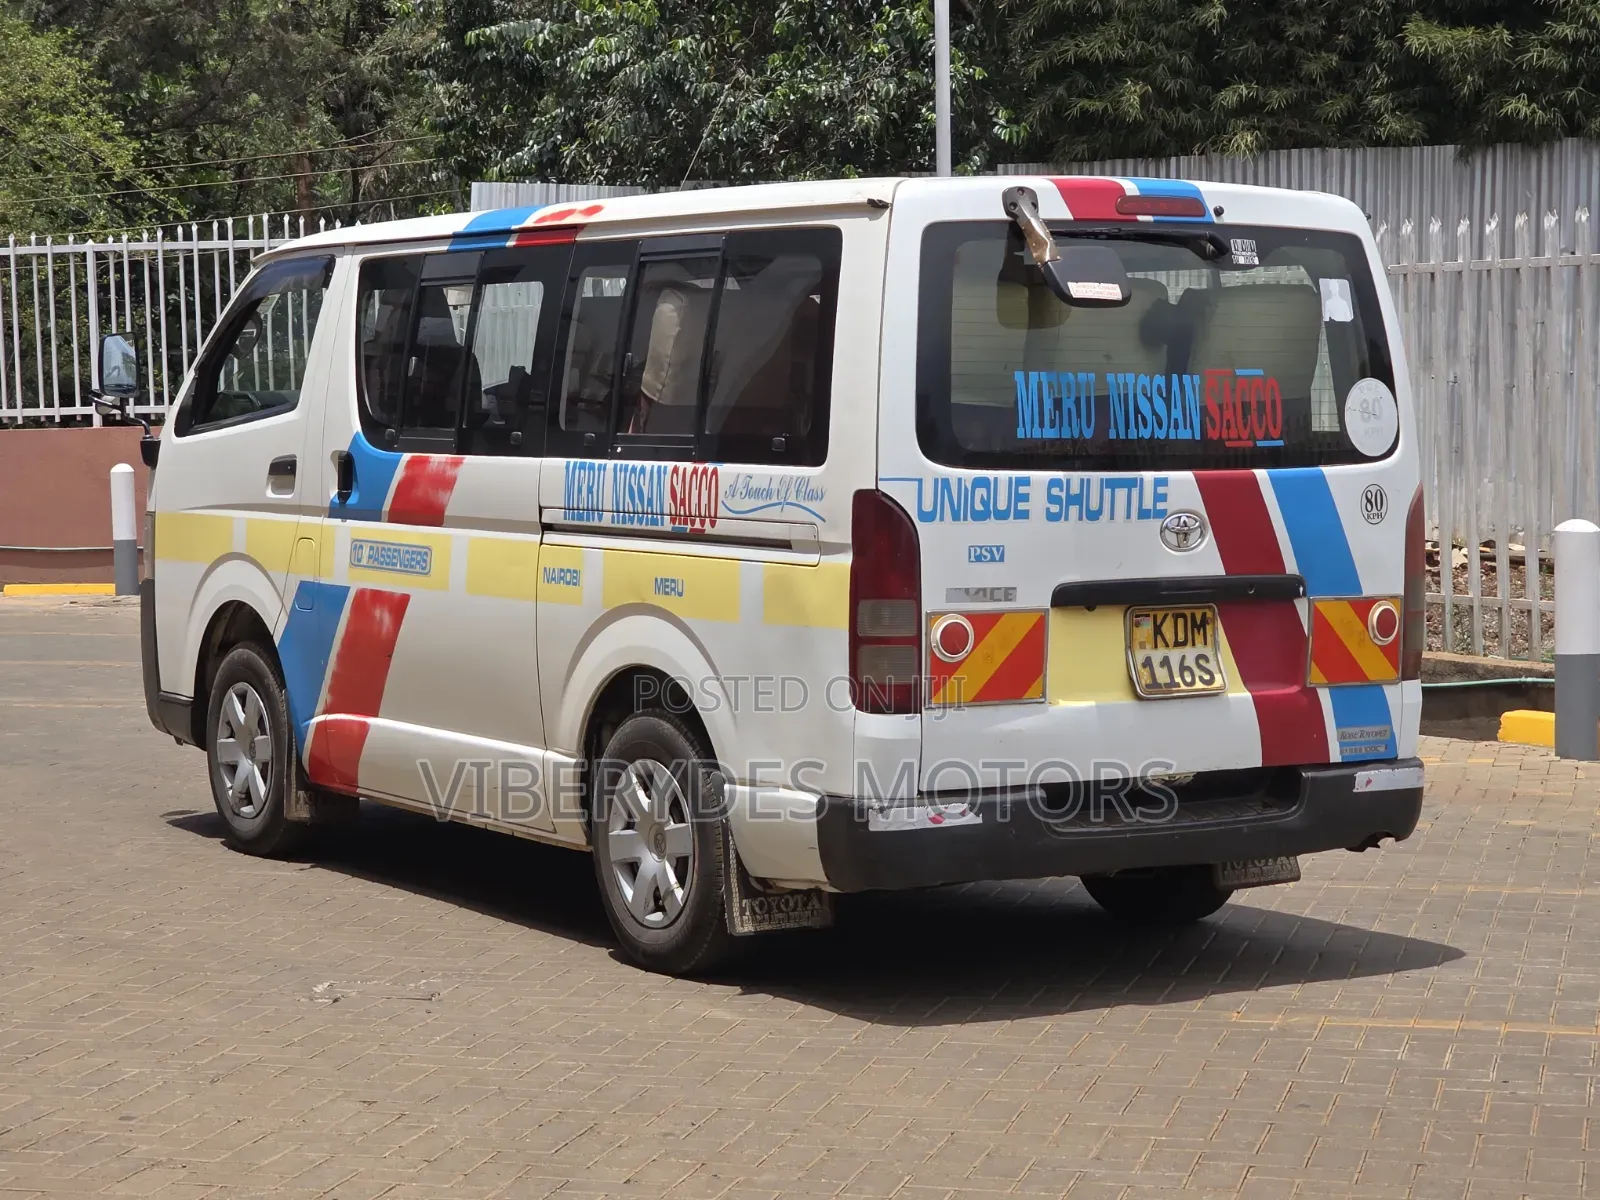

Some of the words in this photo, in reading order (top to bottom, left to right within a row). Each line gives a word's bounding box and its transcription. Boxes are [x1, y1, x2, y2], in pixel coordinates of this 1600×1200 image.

[1015, 371, 1095, 439] MERU
[1106, 373, 1200, 440] NISSAN
[1206, 375, 1283, 441] SACCO
[563, 461, 607, 522] MERU
[611, 463, 668, 527] NISSAN
[669, 464, 720, 530] SACCO
[724, 474, 740, 499] A
[740, 474, 775, 501] Touch
[794, 475, 826, 503] Class
[917, 476, 1031, 523] UNIQUE
[1045, 476, 1169, 523] SHUTTLE
[1364, 488, 1384, 513] 80
[1366, 511, 1383, 521] KPH
[352, 543, 364, 564] 10
[367, 545, 429, 571] PASSENGERS
[968, 545, 1004, 563] PSV
[542, 566, 581, 588] NAIROBI
[654, 576, 685, 598] MERU
[1152, 611, 1208, 649] KDM
[1141, 653, 1216, 689] 116S
[742, 892, 822, 916] TOYOTA
